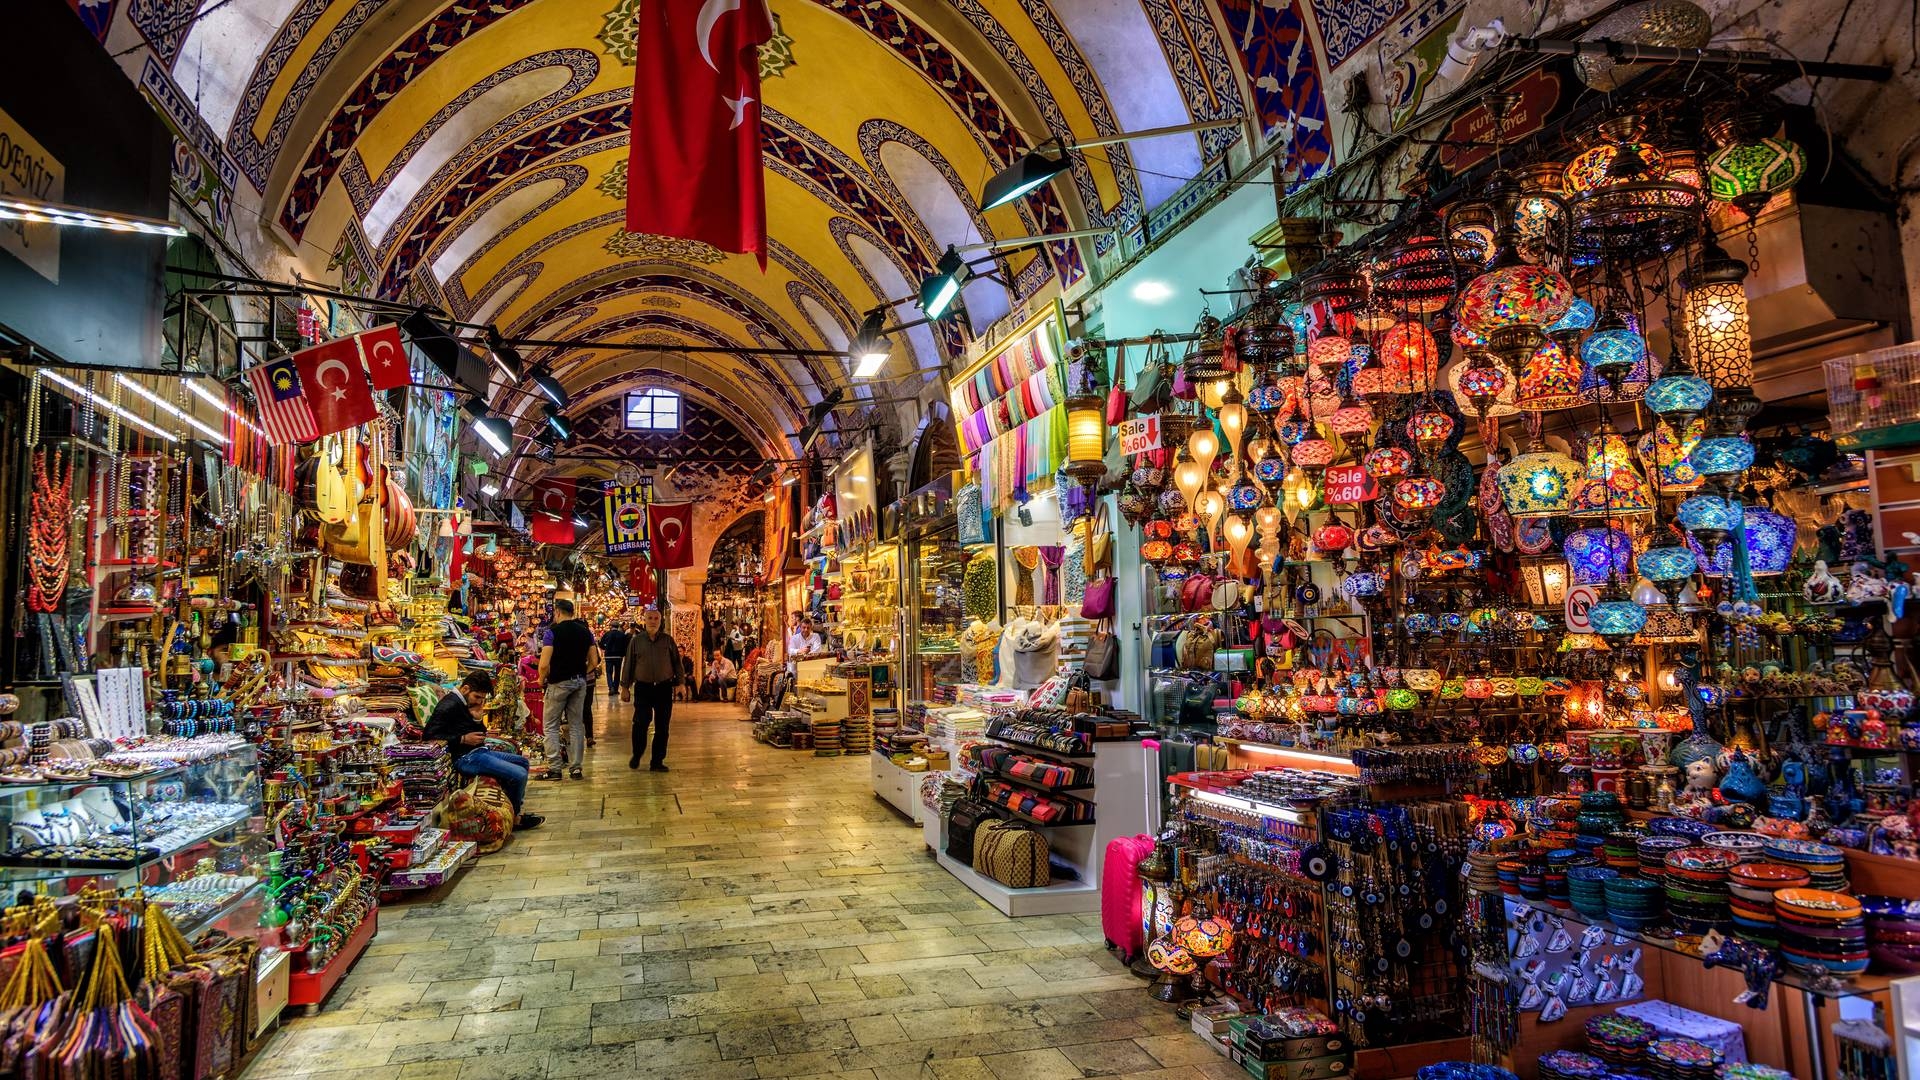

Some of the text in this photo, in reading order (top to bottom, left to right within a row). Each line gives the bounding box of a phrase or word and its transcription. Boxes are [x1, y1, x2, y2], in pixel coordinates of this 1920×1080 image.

[1121, 421, 1145, 437] Sale
[1121, 436, 1147, 454] %60
[1327, 469, 1362, 484] Sale
[1327, 485, 1362, 503] %60
[609, 540, 651, 552] FENERBAHÇ
